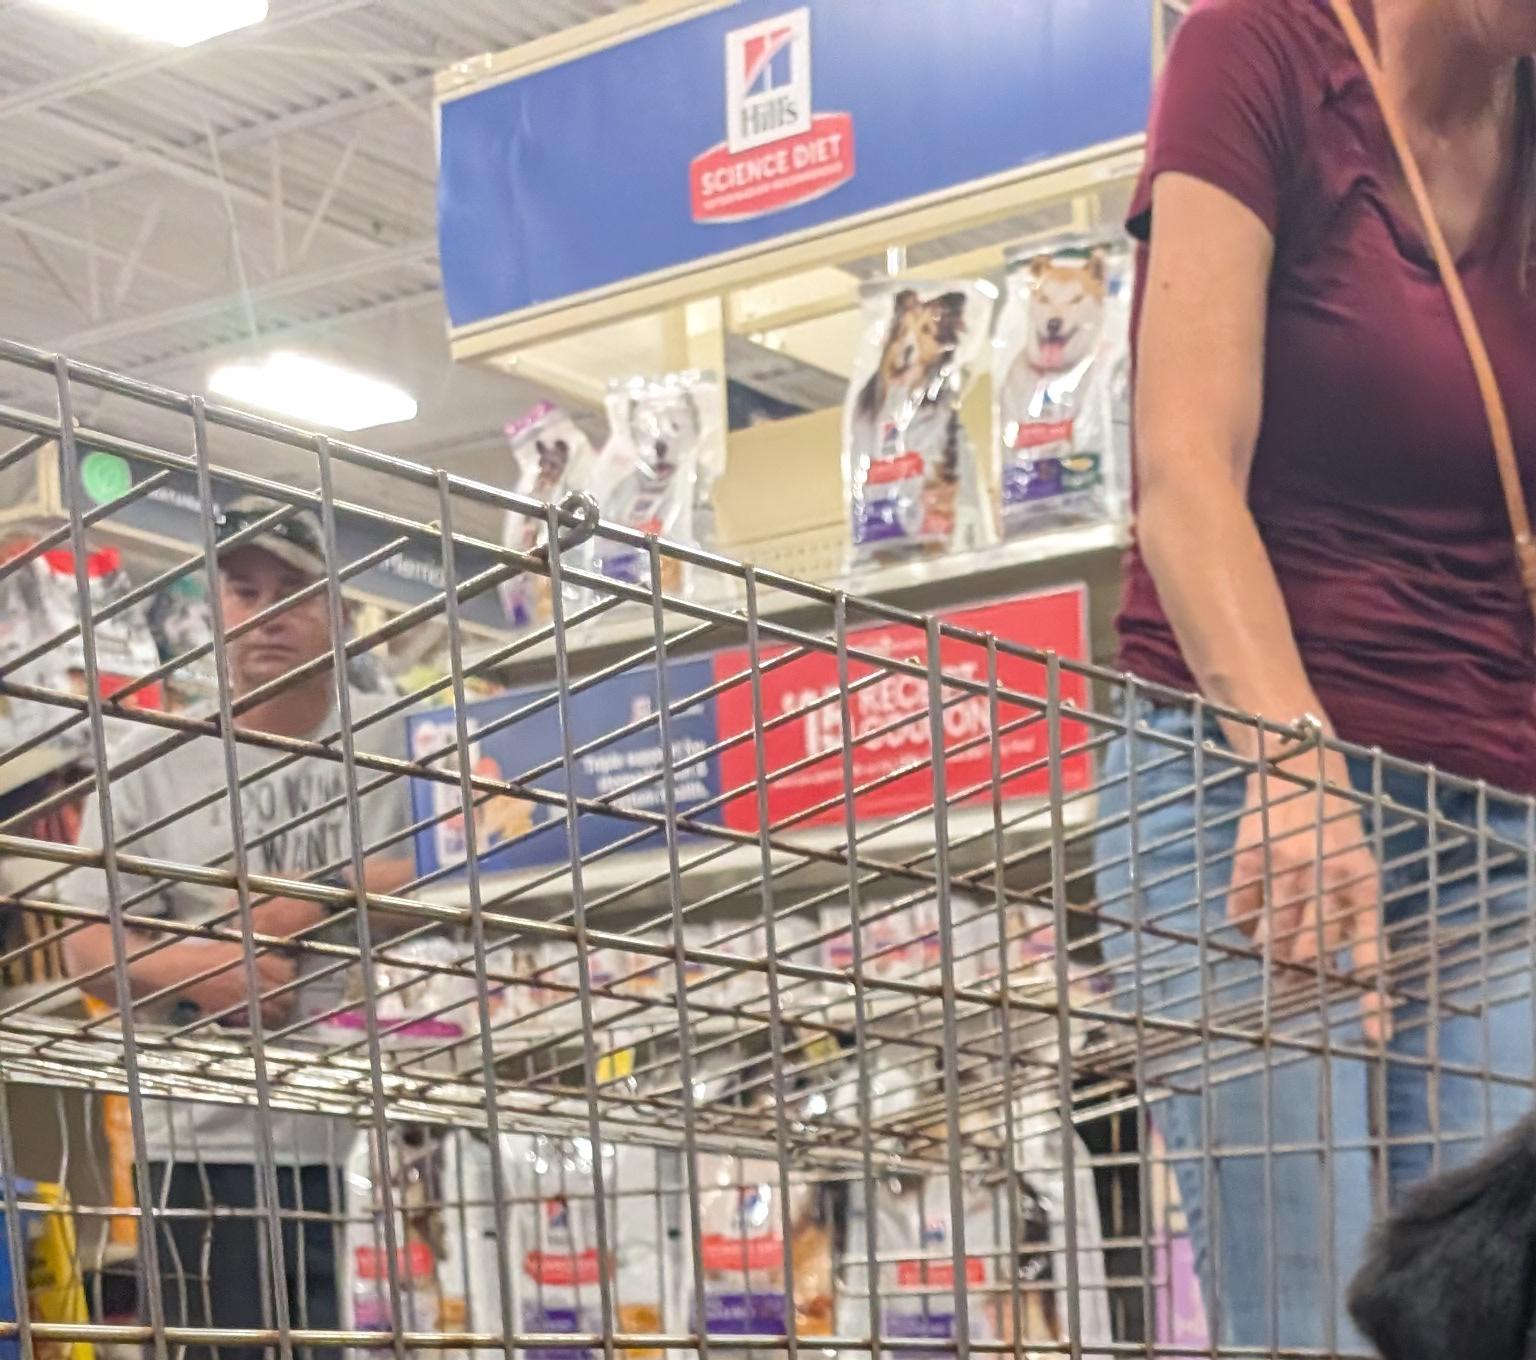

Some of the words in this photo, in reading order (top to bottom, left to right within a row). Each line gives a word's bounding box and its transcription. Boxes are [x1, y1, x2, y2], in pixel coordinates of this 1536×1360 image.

[741, 96, 799, 138] Hill's
[701, 150, 789, 196] SCIENCE
[792, 134, 842, 169] DIET
[857, 690, 992, 750] COUON
